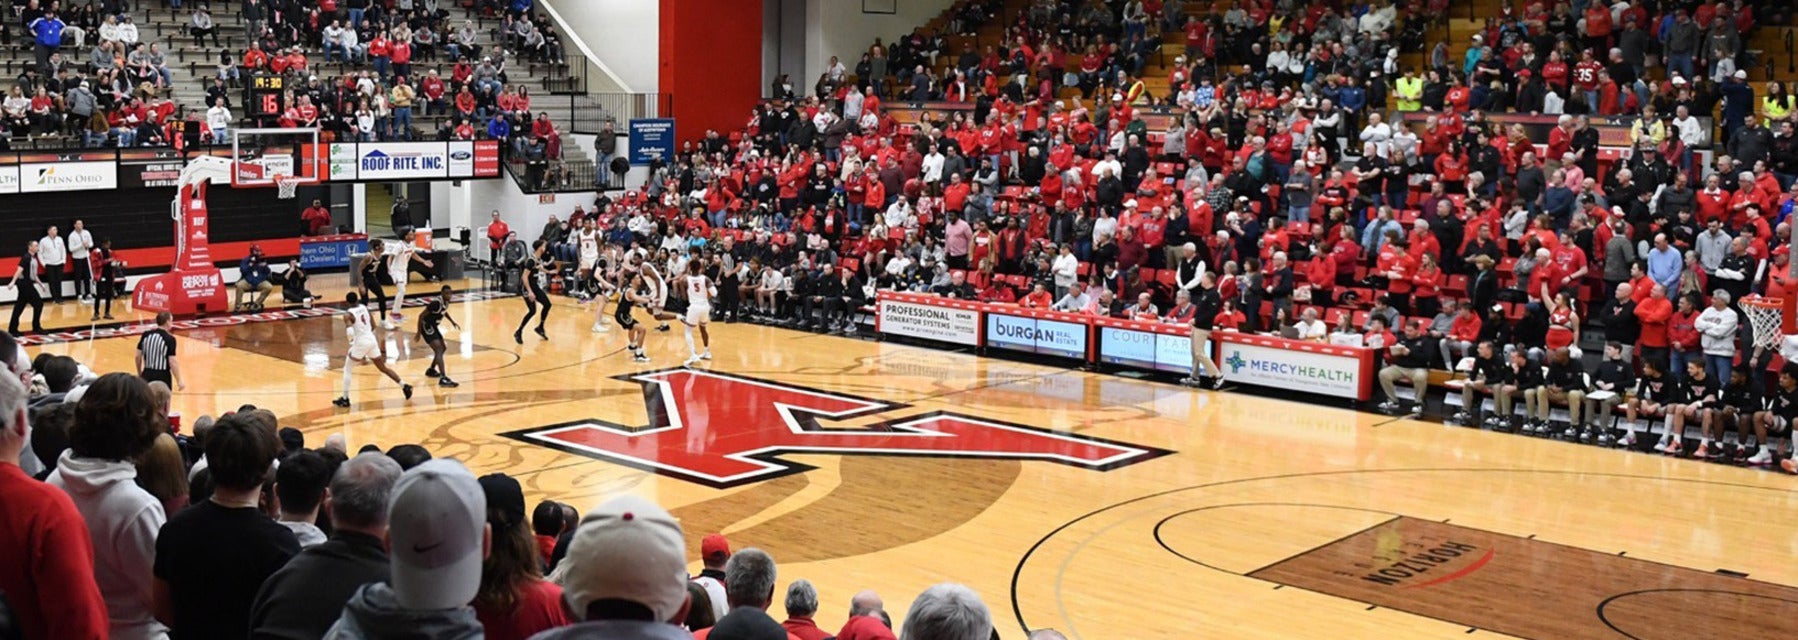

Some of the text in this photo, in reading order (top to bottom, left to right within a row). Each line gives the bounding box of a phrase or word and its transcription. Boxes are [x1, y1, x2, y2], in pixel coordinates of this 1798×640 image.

[255, 77, 282, 89] 19:30
[263, 94, 278, 114] 16
[361, 158, 391, 171] ROOF
[422, 156, 444, 169] INC.
[75, 175, 103, 183] OHIO
[886, 304, 951, 321] PROFESSIONAL
[885, 314, 922, 326] GENERATOR
[922, 320, 951, 330] SYSTEMS
[1250, 359, 1354, 382] MERCYHEALTH
[1360, 541, 1477, 586] HORIZON
